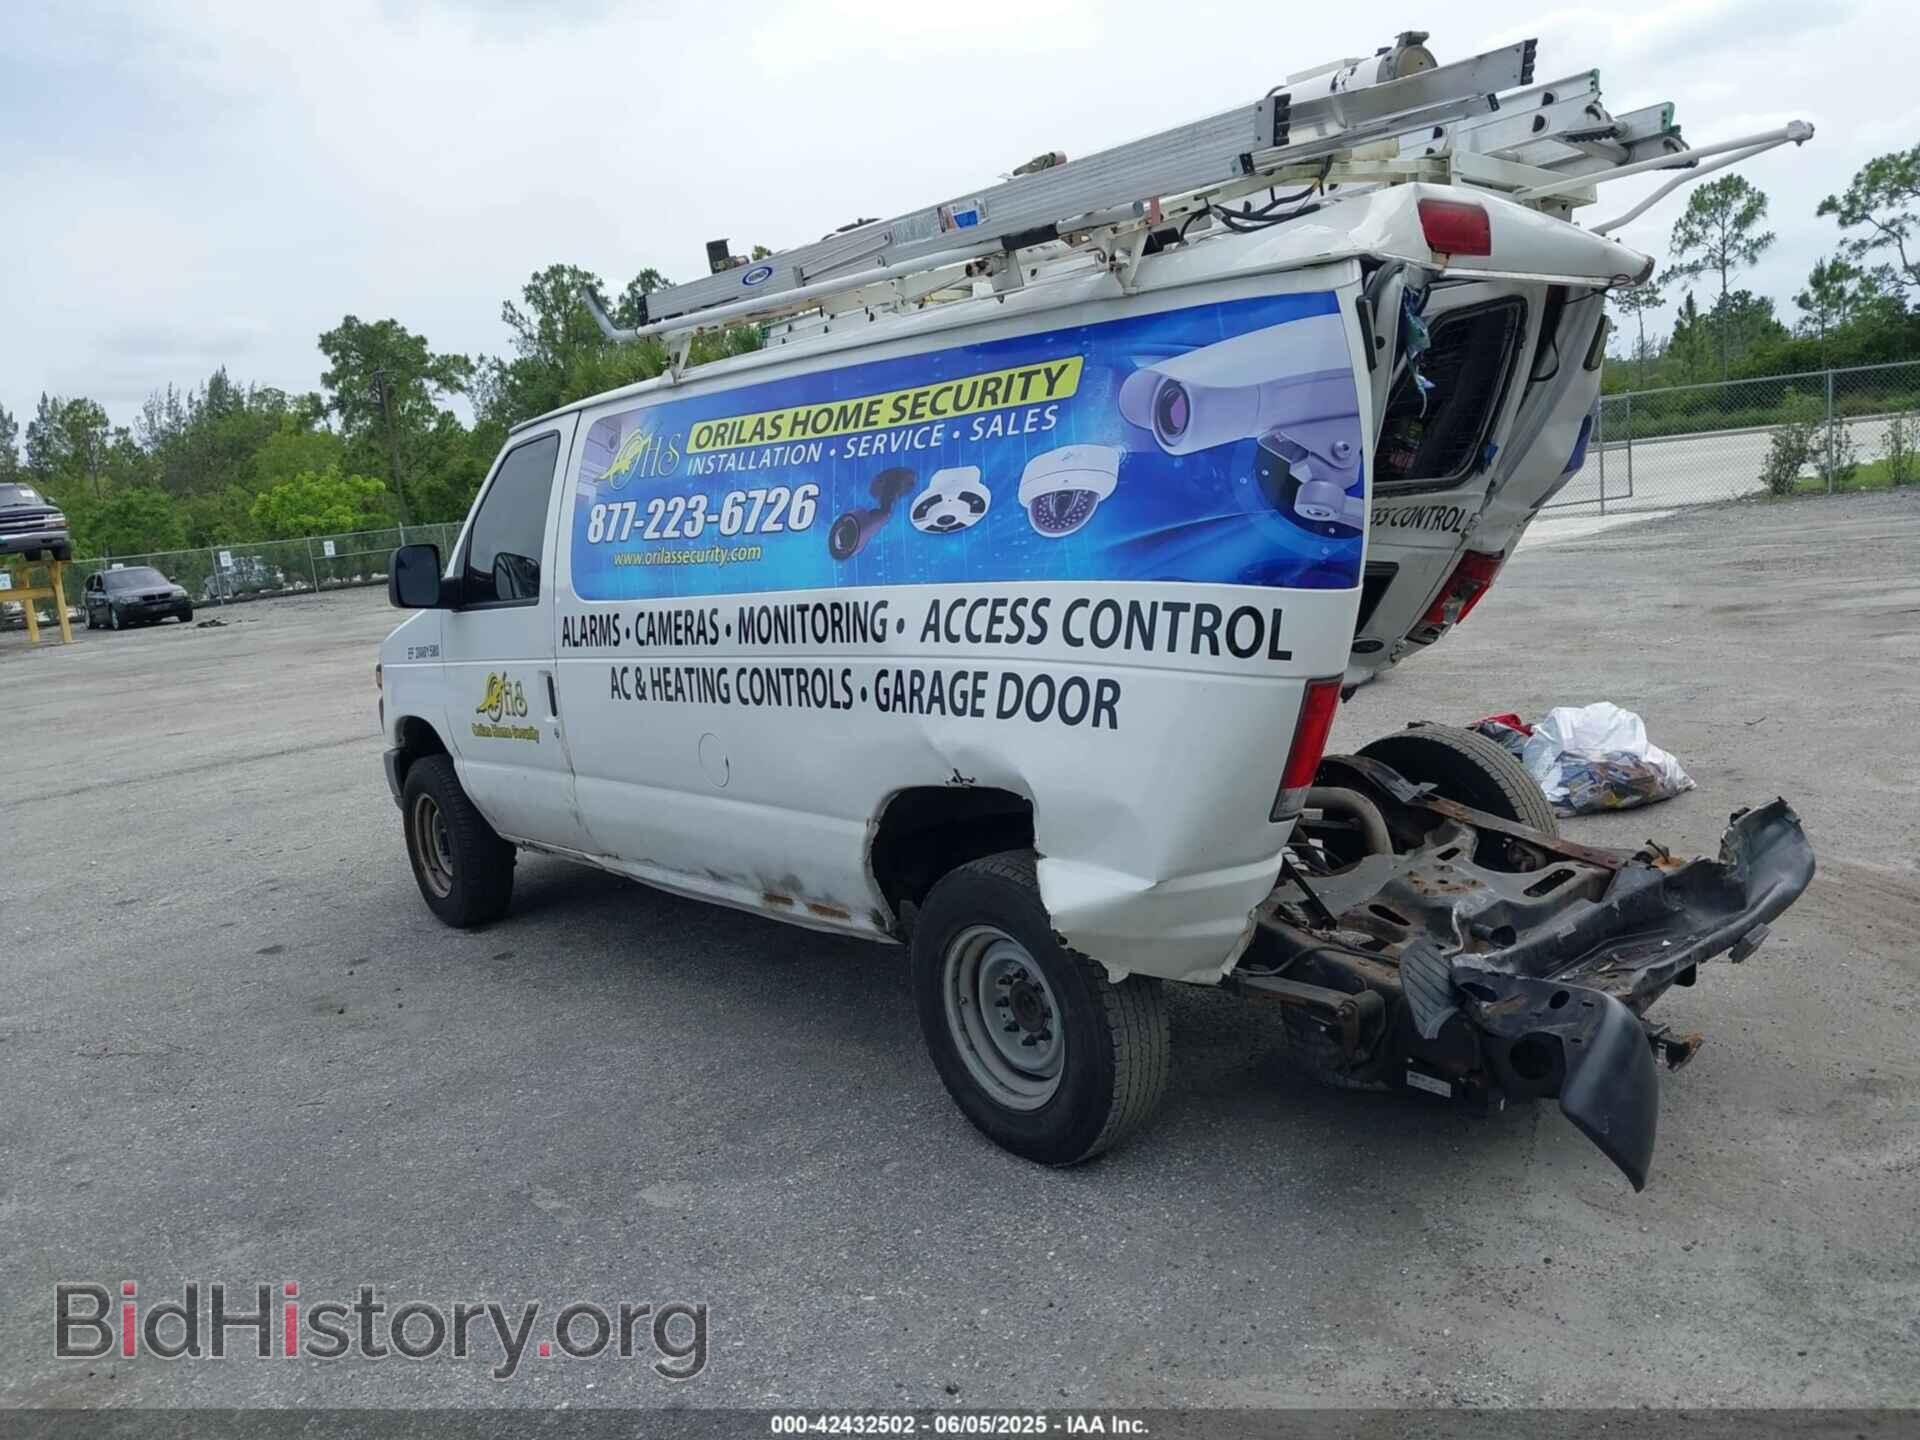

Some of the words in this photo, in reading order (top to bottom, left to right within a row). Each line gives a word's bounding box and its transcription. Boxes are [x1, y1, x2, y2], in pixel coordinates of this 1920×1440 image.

[695, 413, 783, 449] ORILAS
[788, 398, 883, 437] HOME
[888, 363, 1070, 424] SECURITY
[687, 442, 824, 476] INSTALLATION
[843, 423, 946, 459] SERVICE
[969, 405, 1059, 441] SALES
[586, 483, 820, 544] 877-223-6726
[1389, 505, 1466, 533] CONTROL
[613, 545, 762, 567] www.orilassecurity.com
[562, 612, 621, 648] ALARMS
[635, 608, 719, 647] CAMERAS
[738, 600, 888, 645] MONITORING
[920, 597, 1050, 646] ACCESS
[1061, 598, 1293, 661] CONTROL
[611, 666, 629, 701] AC
[635, 666, 647, 701] &
[650, 667, 731, 705] HEATING
[735, 667, 853, 711] CONTROLS
[874, 668, 989, 718] GARAGE
[996, 672, 1122, 730] DOOR
